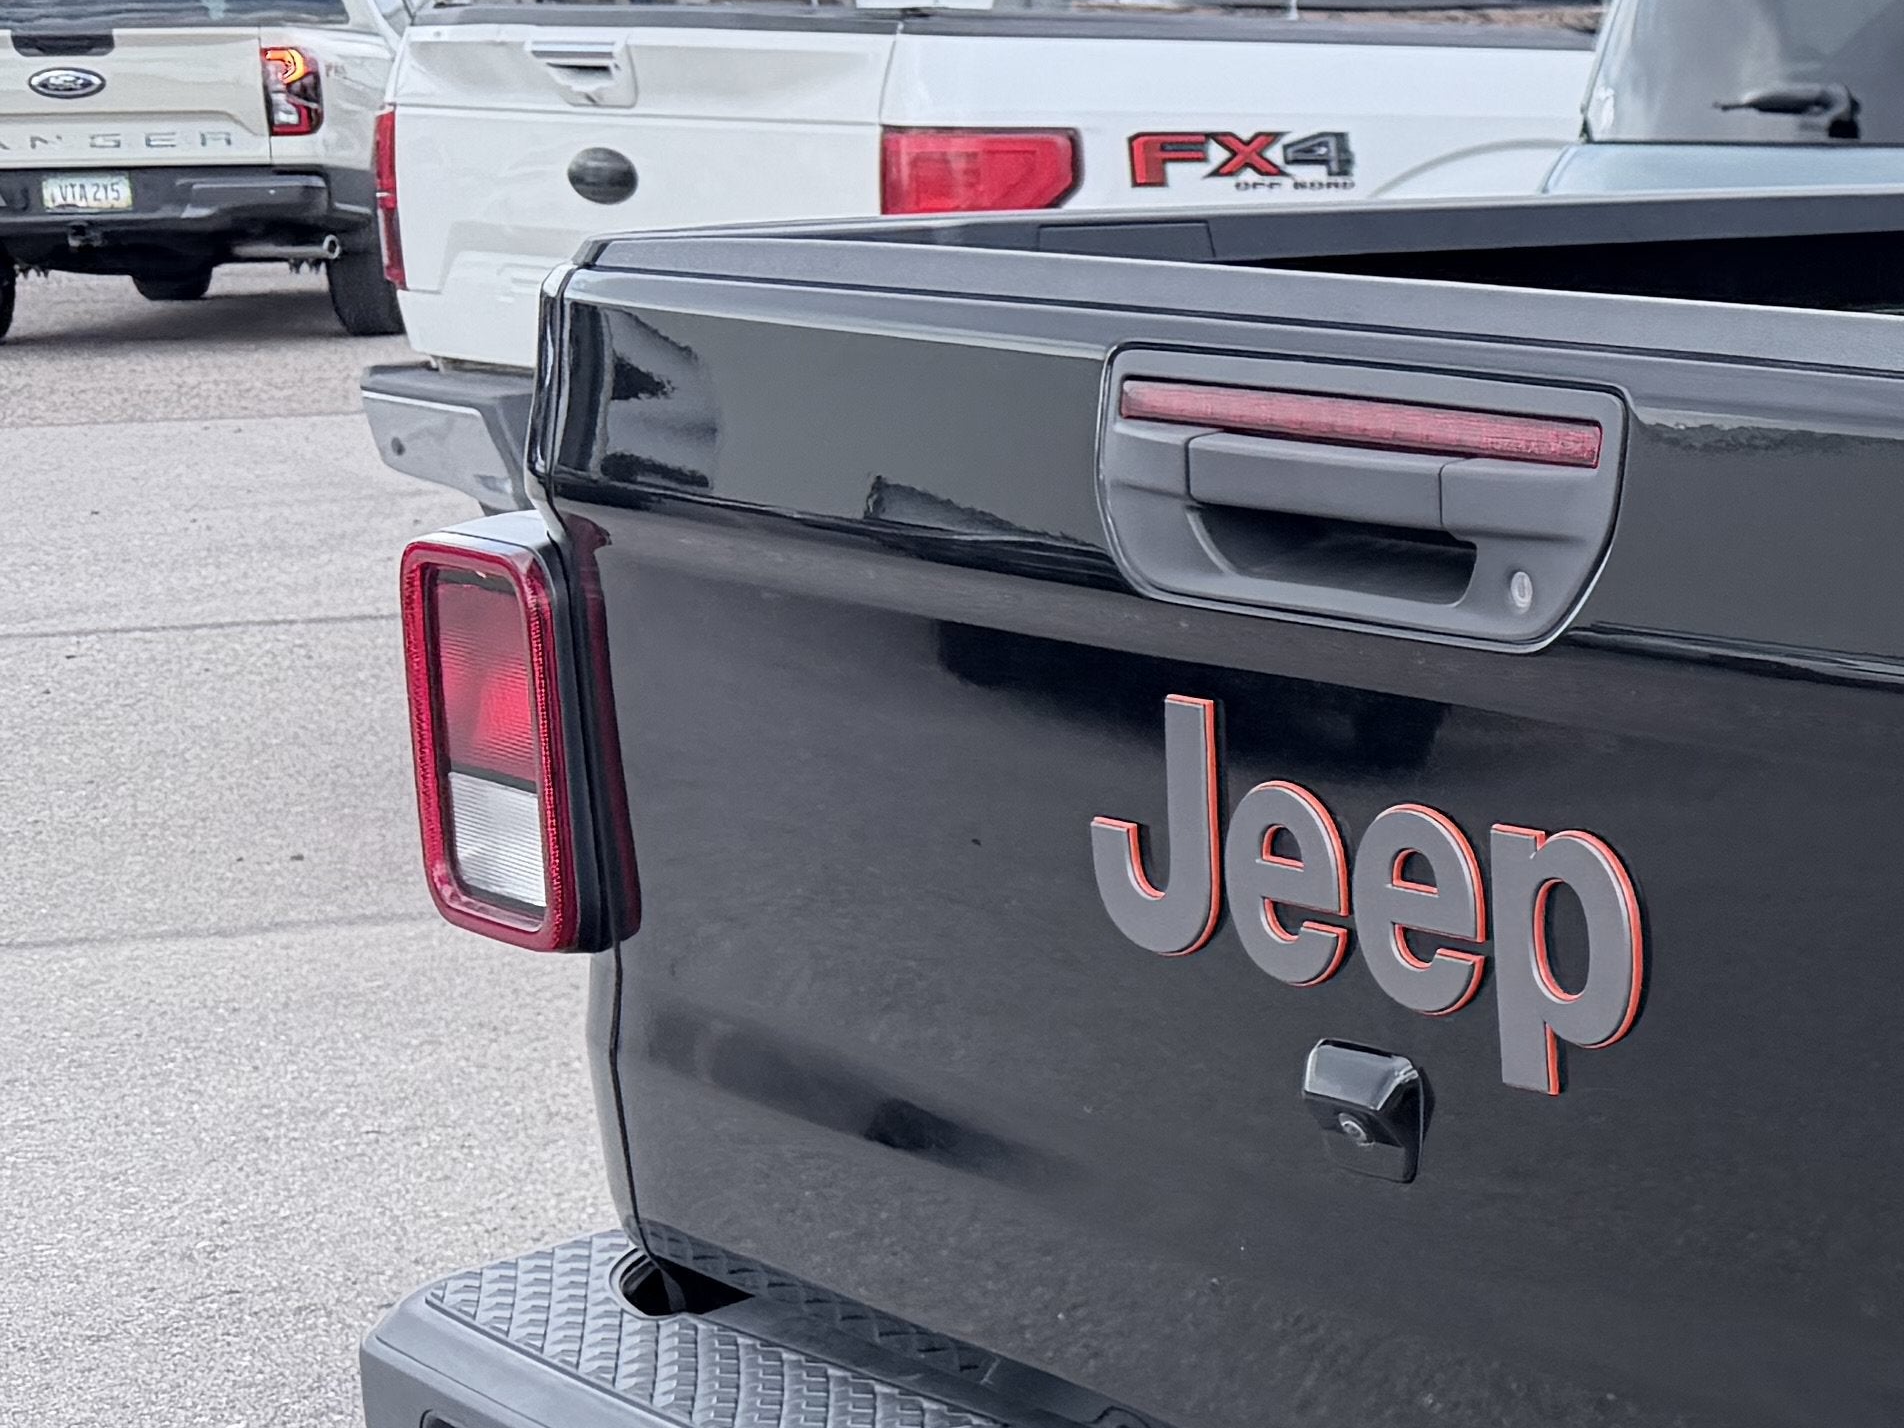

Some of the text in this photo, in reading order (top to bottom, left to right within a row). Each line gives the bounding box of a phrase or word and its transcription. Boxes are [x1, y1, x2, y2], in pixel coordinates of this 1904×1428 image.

[1128, 131, 1354, 188] FX4
[1235, 181, 1281, 191] OFF
[1091, 693, 1643, 1096] Jeep
